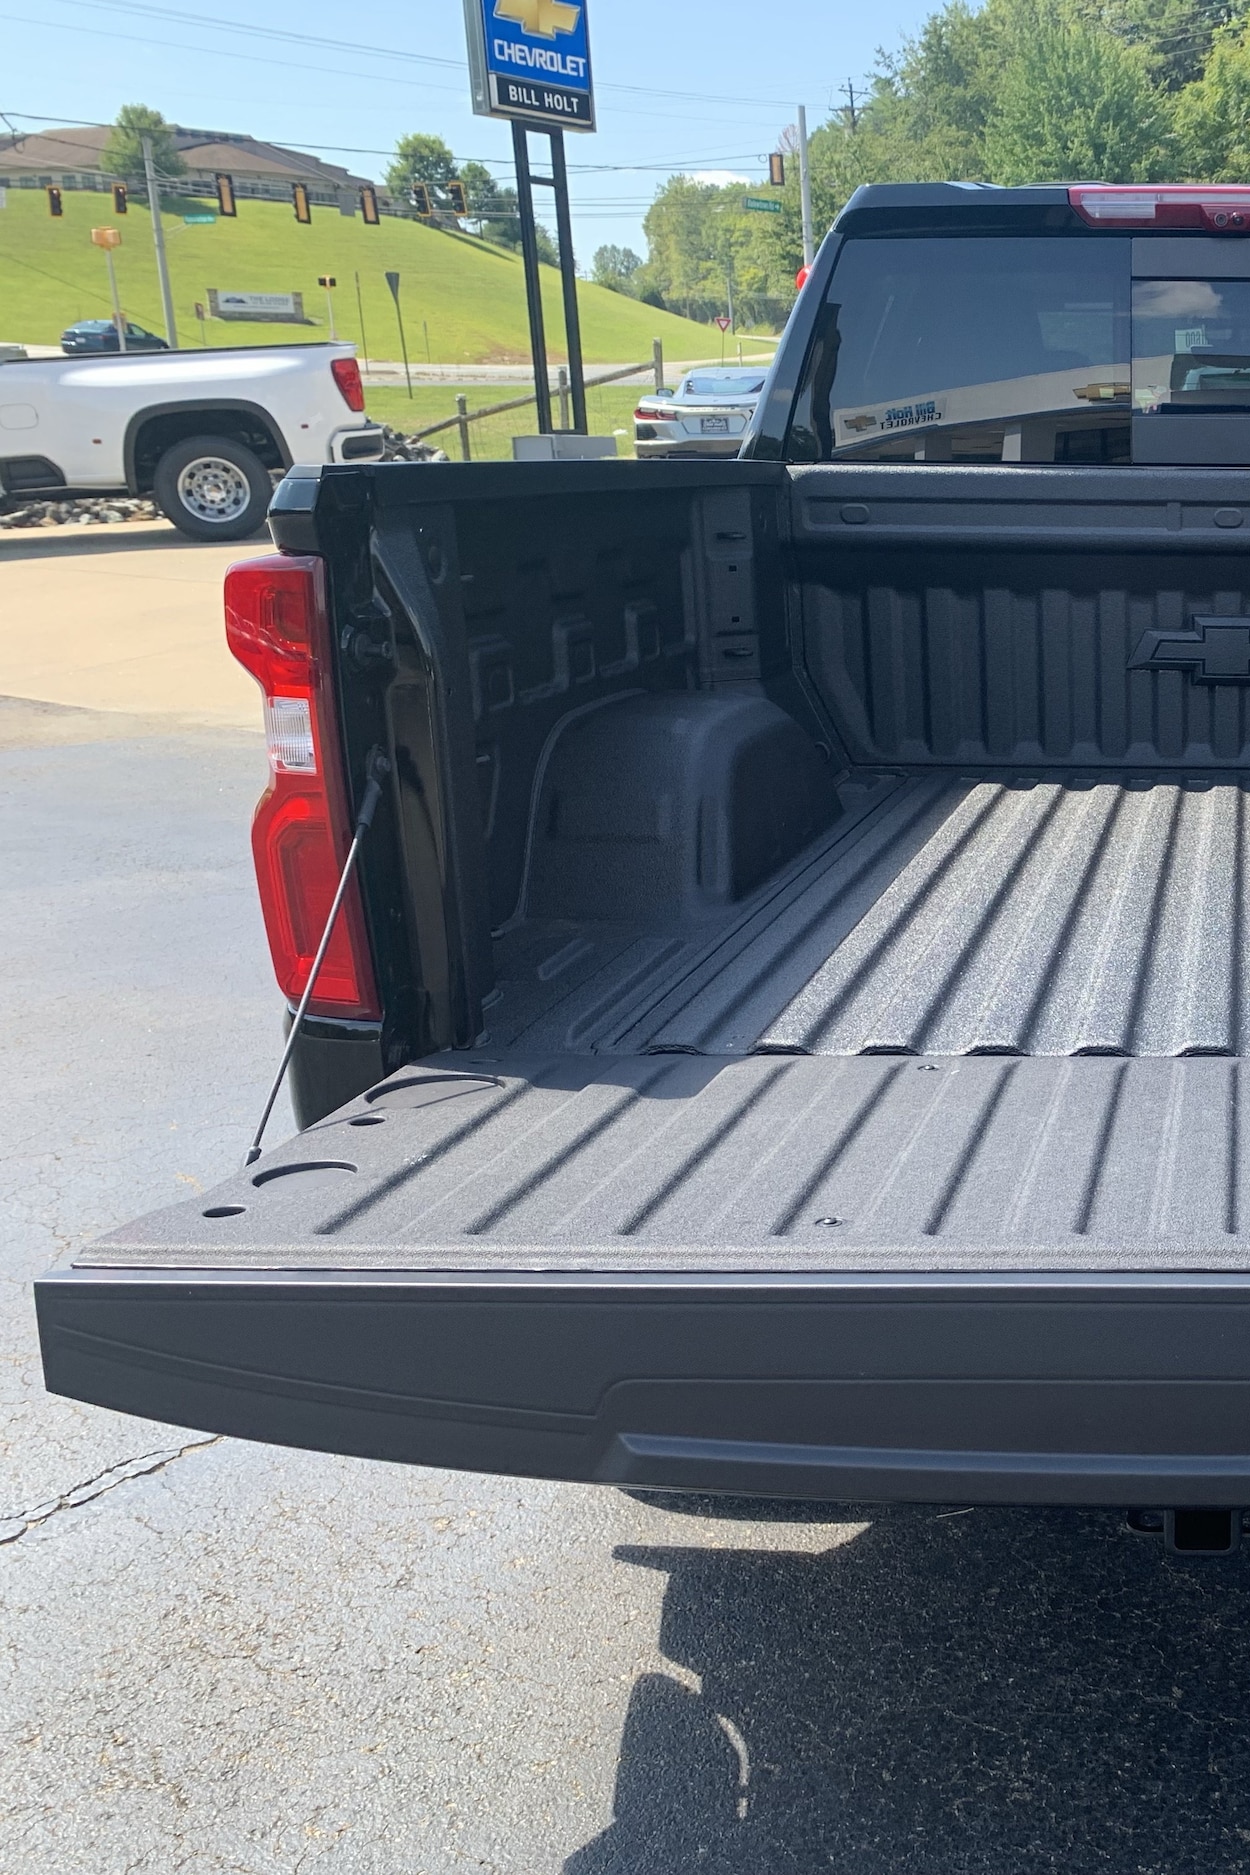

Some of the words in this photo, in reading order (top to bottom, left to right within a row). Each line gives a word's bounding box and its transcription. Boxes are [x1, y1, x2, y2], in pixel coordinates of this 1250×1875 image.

[494, 39, 585, 77] CHEVROLET
[508, 84, 540, 106] BILL
[543, 92, 579, 113] HOLT
